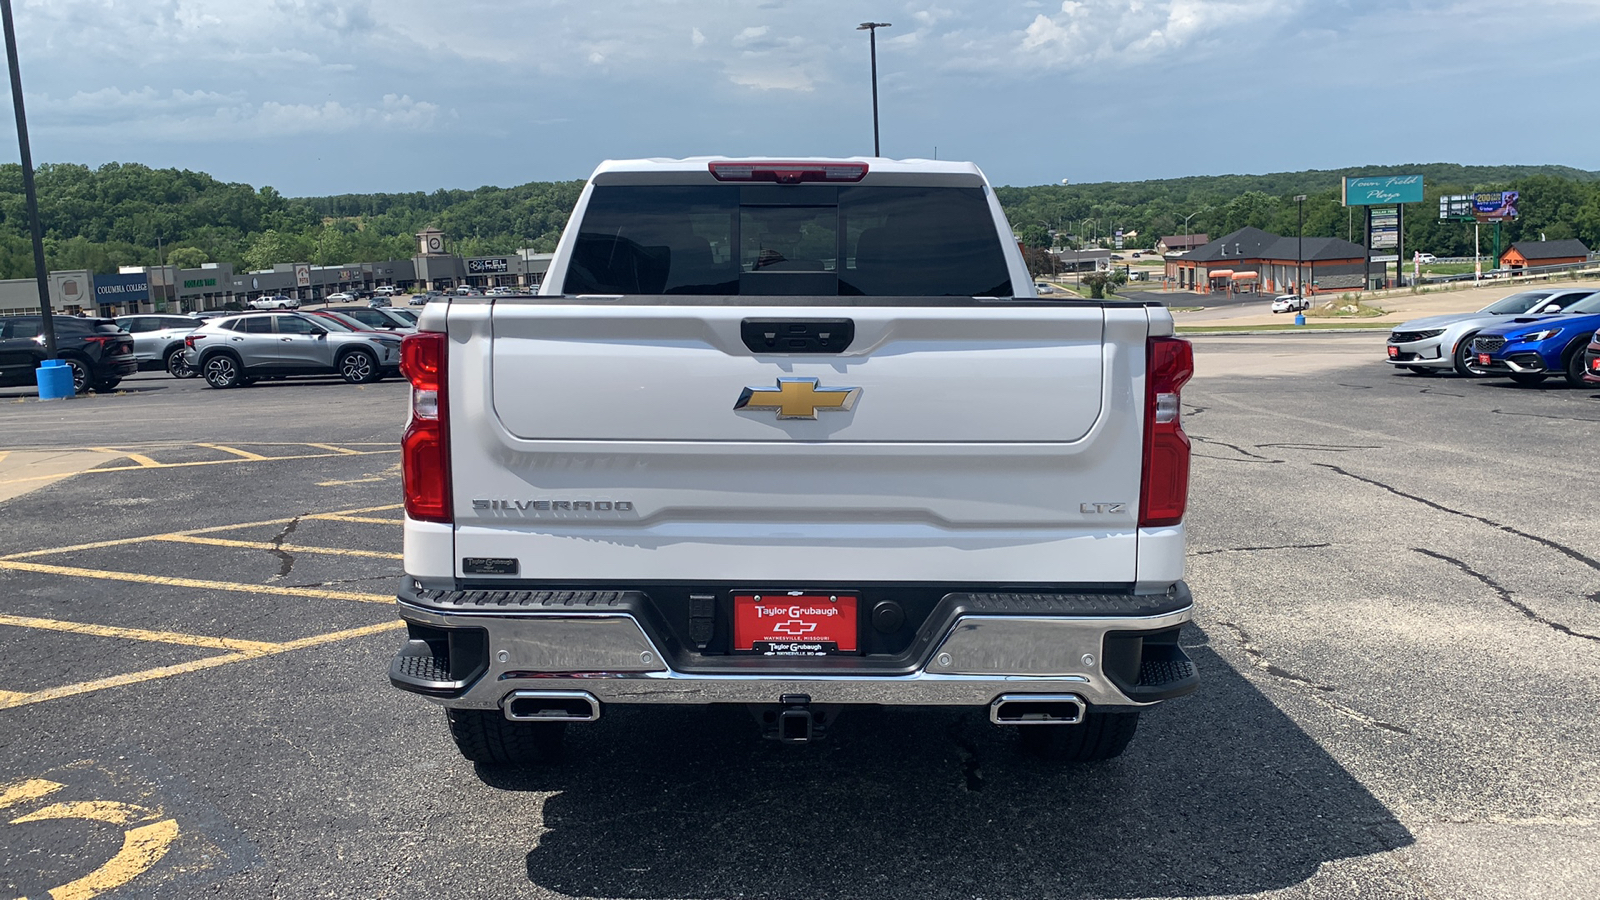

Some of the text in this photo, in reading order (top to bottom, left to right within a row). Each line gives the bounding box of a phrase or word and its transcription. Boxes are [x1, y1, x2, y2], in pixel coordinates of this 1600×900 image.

[1350, 175, 1419, 188] Town Field
[97, 283, 148, 295] COLUMBIA COLLEGE
[472, 499, 633, 512] SILVERADO
[1079, 502, 1126, 514] LTZ
[754, 605, 838, 618] Taylor Grubaugh
[768, 642, 822, 651] Taylor Grubaugh
